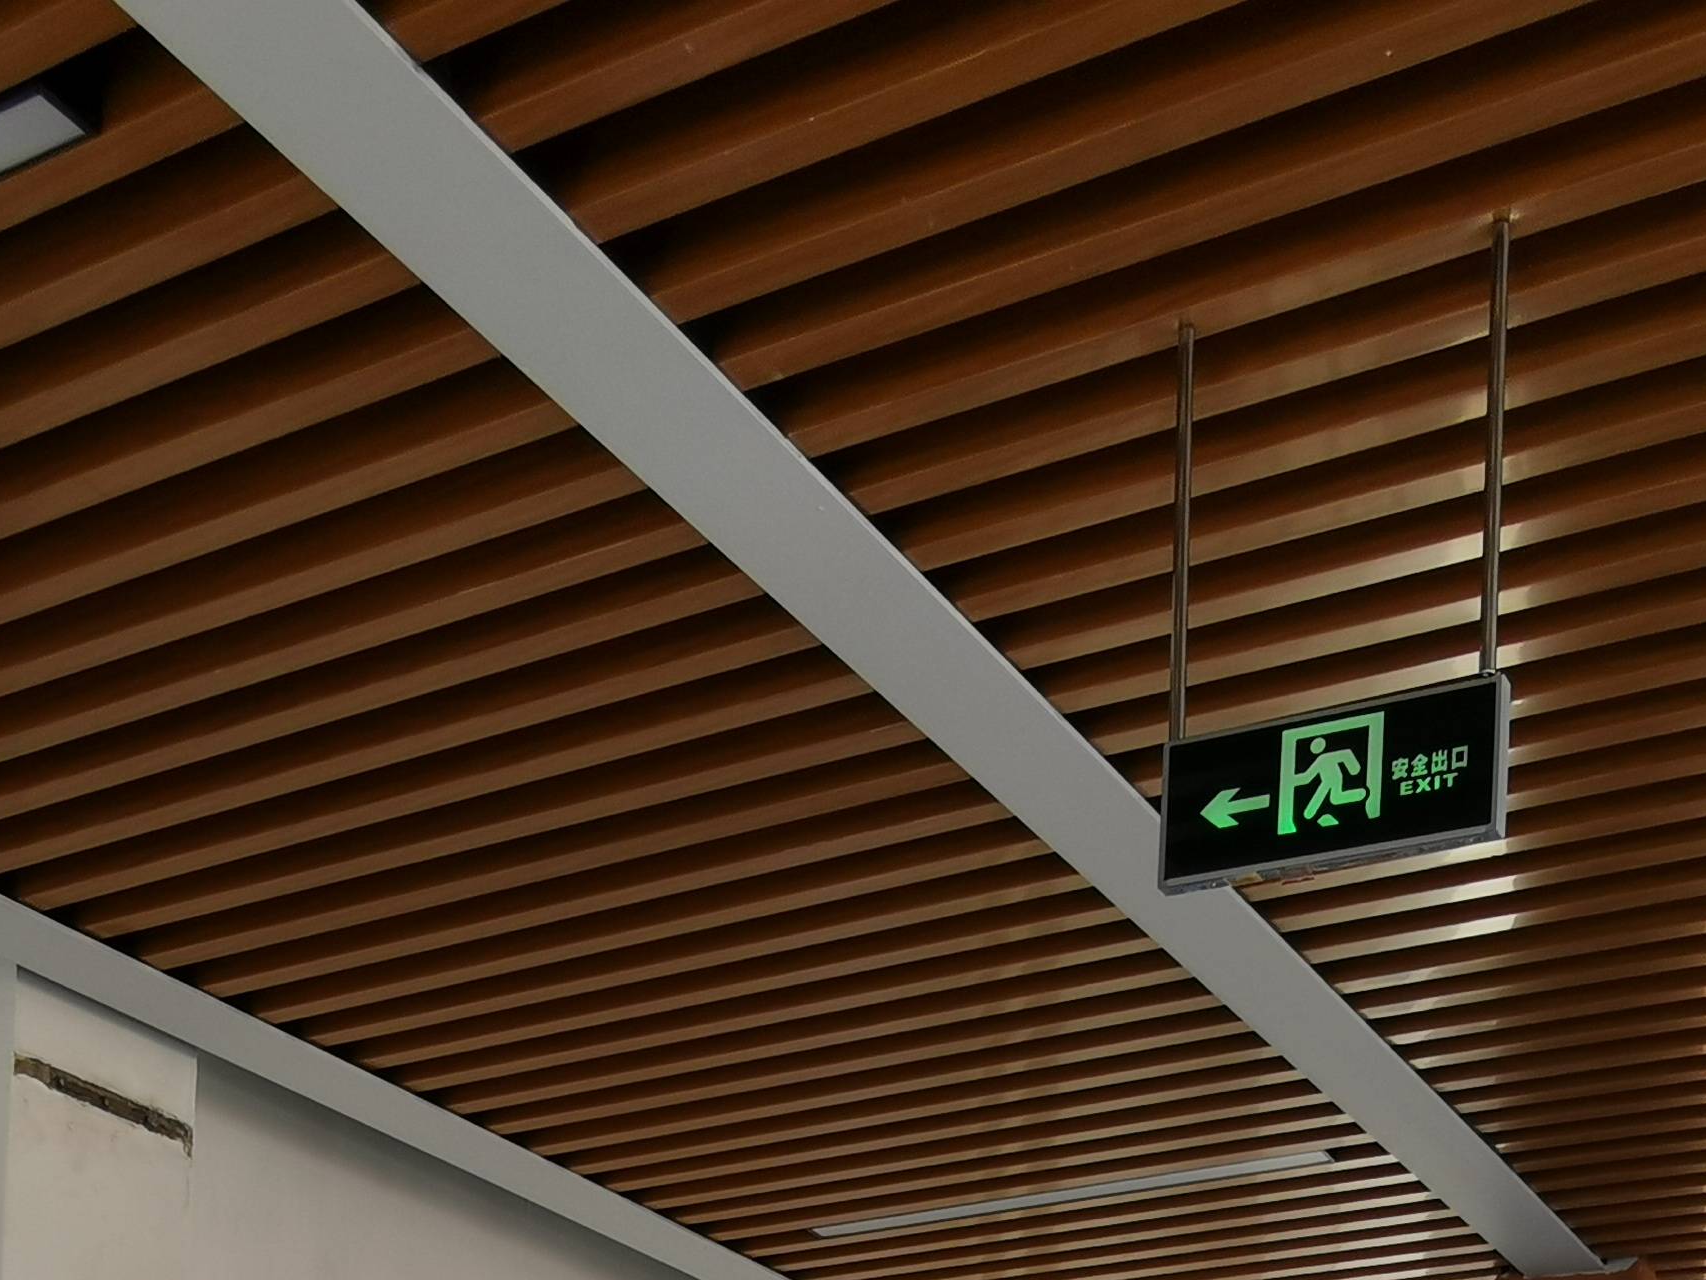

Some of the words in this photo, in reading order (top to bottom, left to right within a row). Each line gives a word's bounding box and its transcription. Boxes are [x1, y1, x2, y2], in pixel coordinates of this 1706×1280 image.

[1391, 744, 1469, 781] 安全出口
[1400, 772, 1459, 797] EXIT
